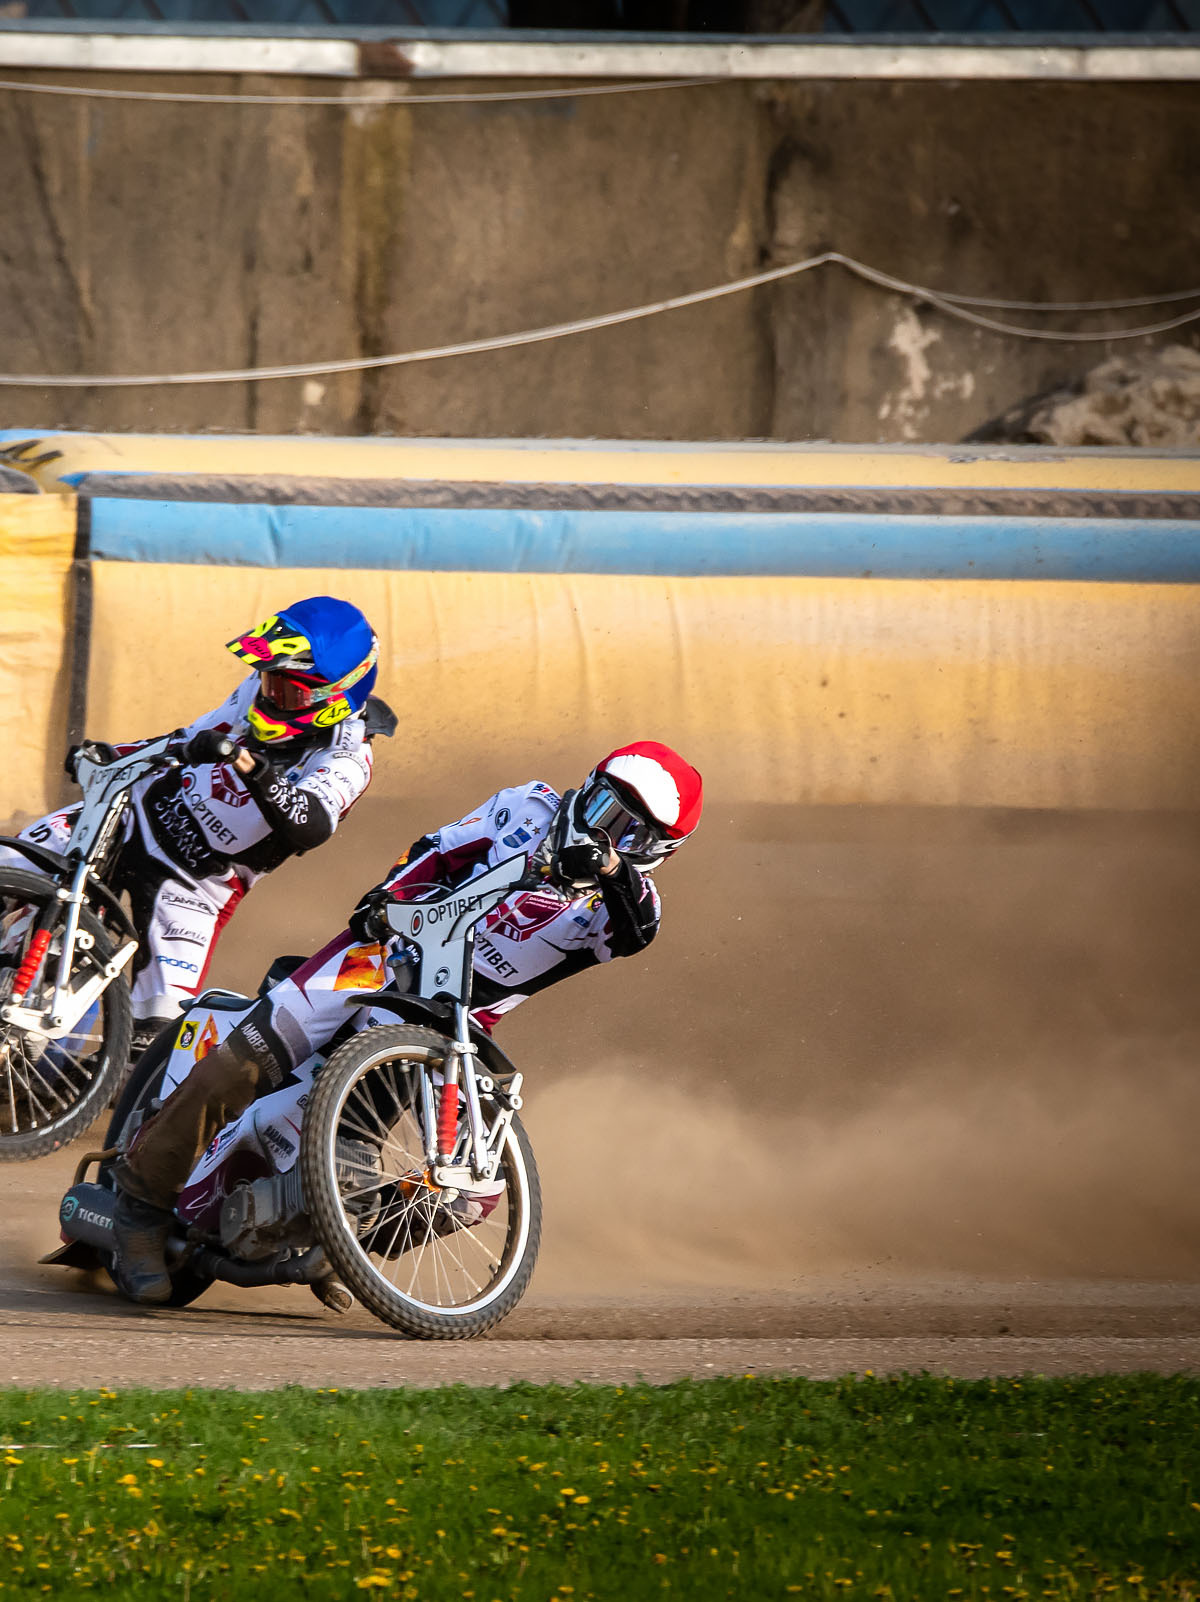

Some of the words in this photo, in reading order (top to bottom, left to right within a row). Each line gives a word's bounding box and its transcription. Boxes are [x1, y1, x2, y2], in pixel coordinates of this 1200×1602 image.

[191, 793, 238, 846] OPTIBET
[427, 893, 484, 924] OPTIBET
[474, 931, 519, 979] PTIBET
